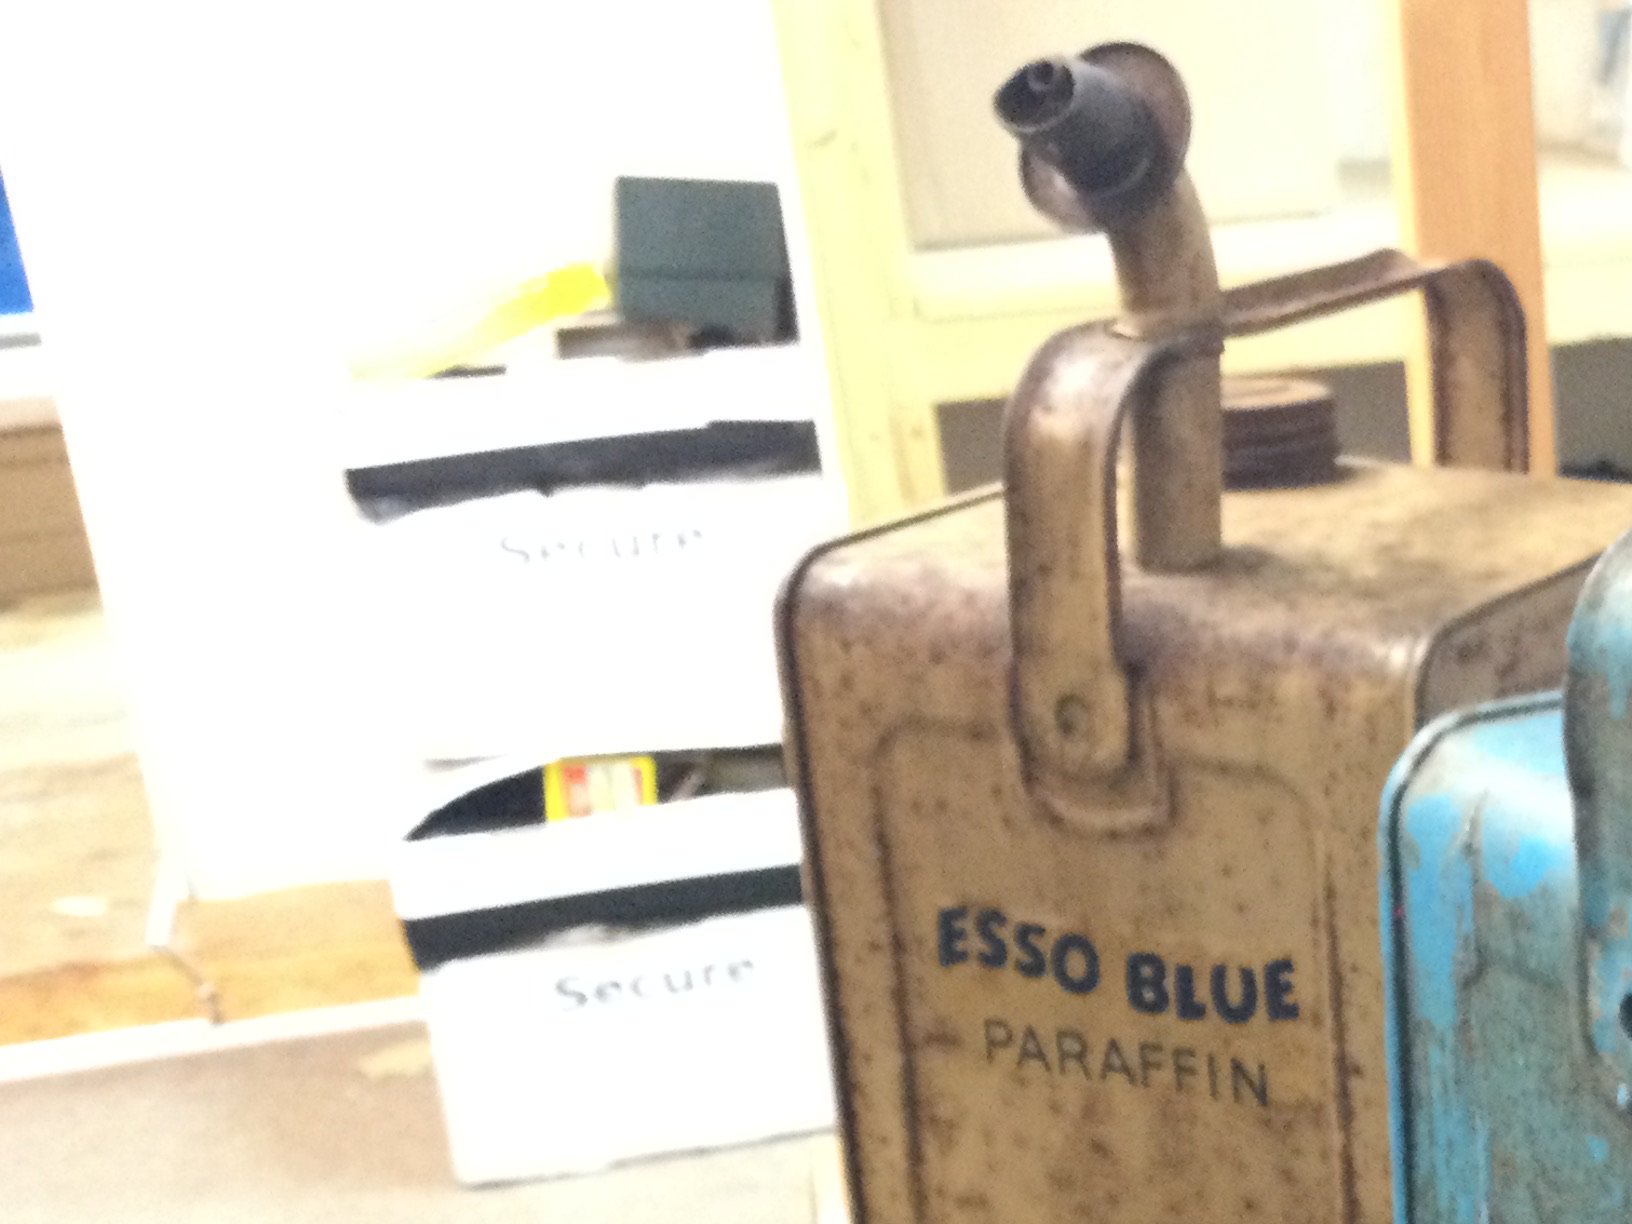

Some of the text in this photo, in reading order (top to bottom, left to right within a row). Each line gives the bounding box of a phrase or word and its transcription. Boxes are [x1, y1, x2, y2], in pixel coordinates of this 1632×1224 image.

[554, 958, 755, 1011] Secure
[937, 905, 1300, 1024] ESSO BLUE
[982, 1017, 1270, 1107] PARAFFIN
